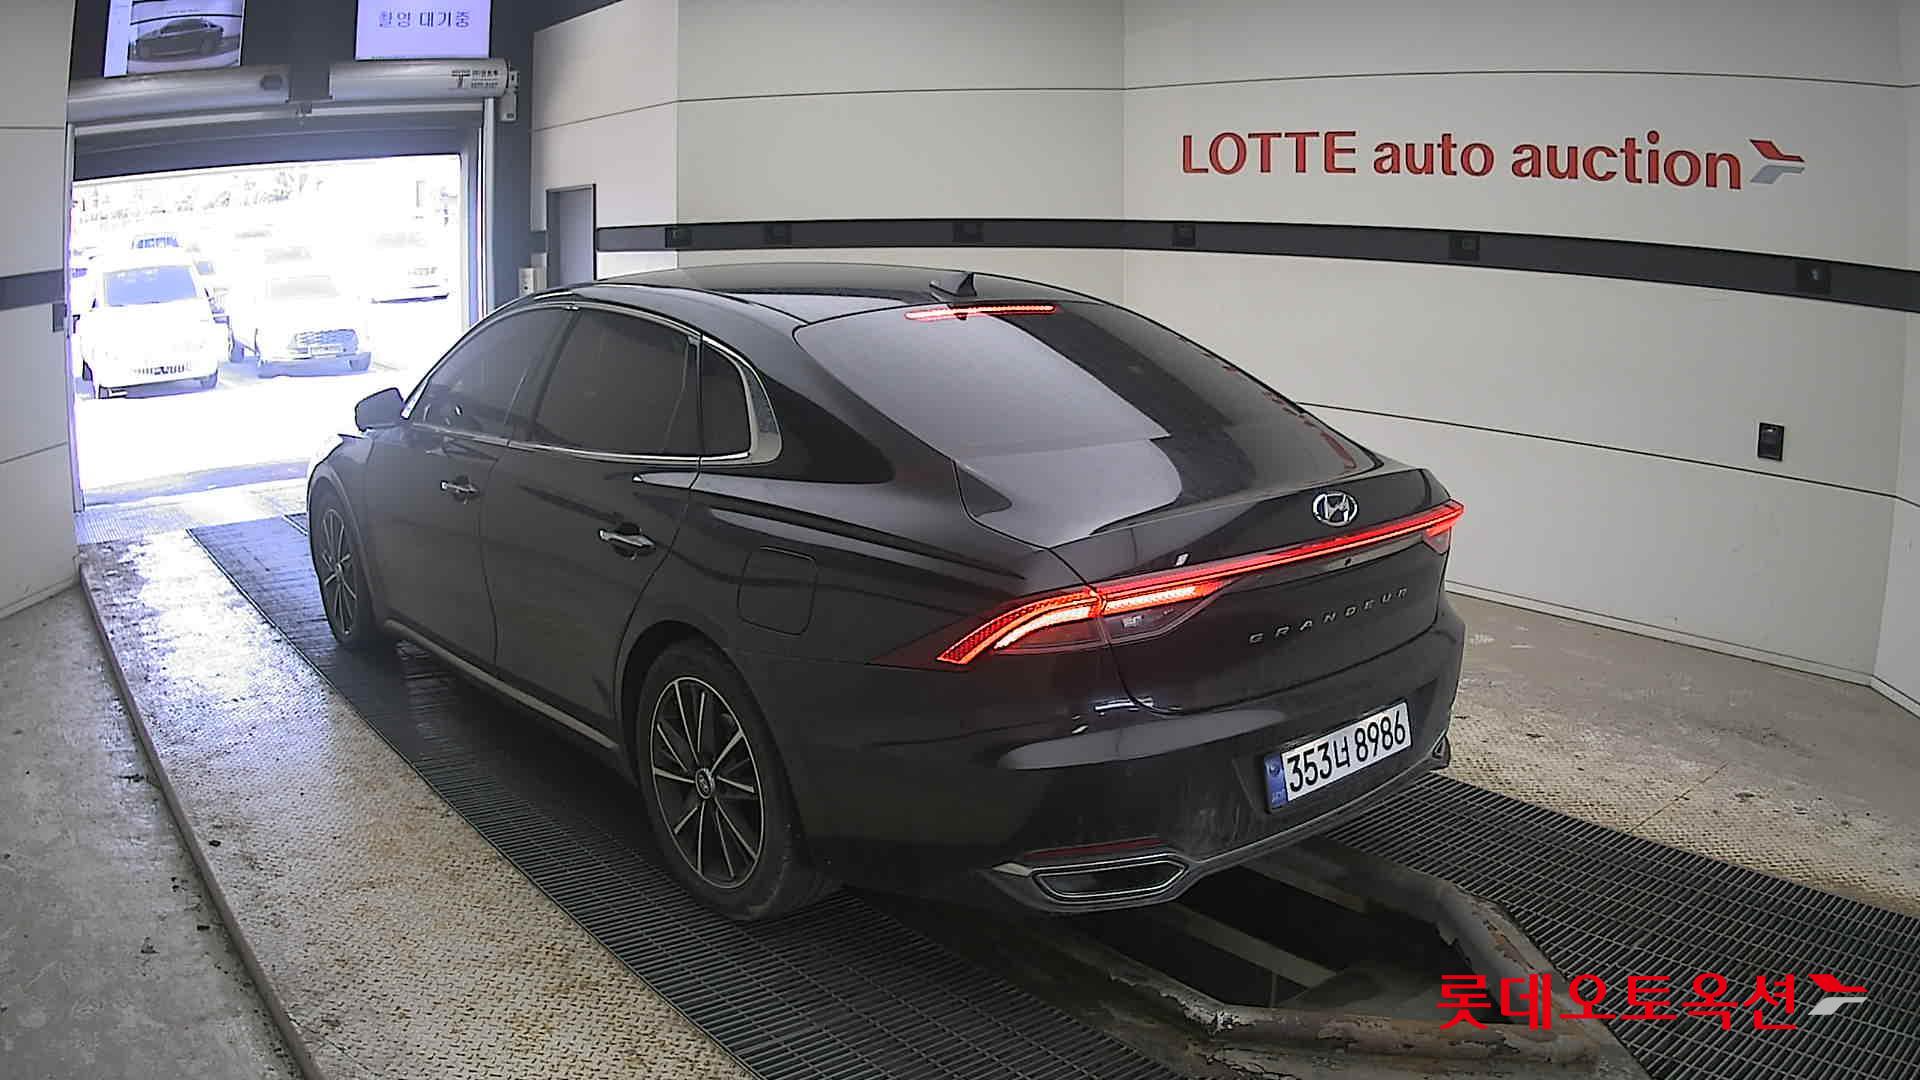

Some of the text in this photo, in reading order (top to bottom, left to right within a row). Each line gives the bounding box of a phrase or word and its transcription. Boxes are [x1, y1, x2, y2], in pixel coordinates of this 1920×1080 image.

[418, 10, 471, 28] 대기중
[1182, 130, 1742, 190] LOTTE auto auction
[1249, 586, 1409, 644] GRANDEUR
[1286, 710, 1406, 793] 353너 8986
